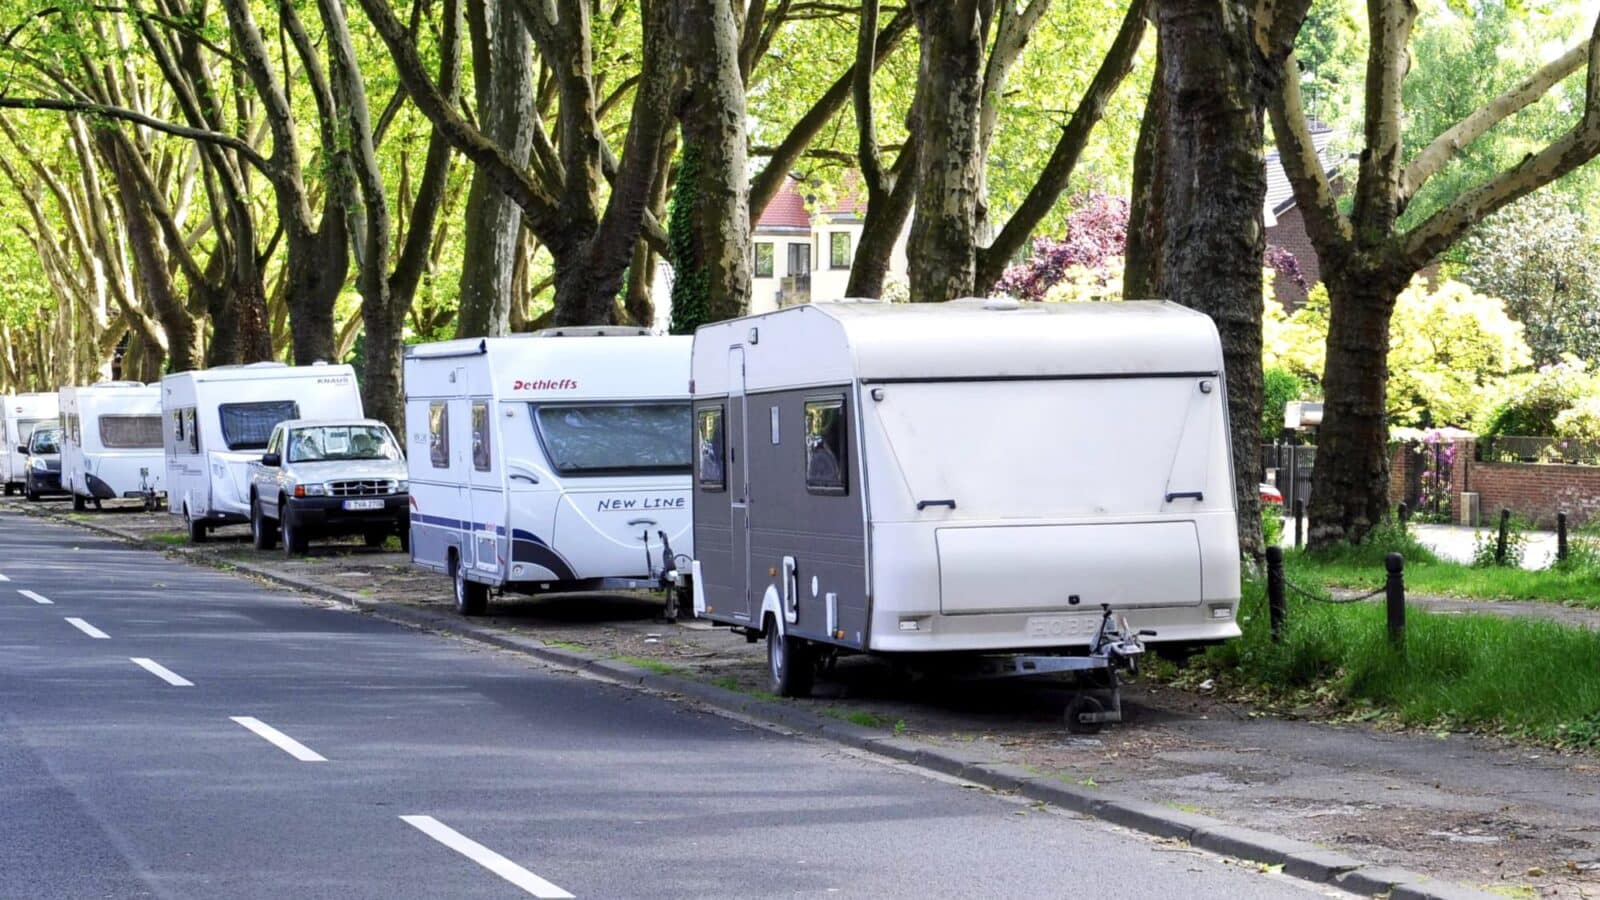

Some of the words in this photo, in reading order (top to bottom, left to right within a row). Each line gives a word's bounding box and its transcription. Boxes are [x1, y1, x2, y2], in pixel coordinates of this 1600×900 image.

[512, 379, 578, 391] Dethleffs
[597, 498, 637, 512] NEW
[643, 497, 686, 509] LINE
[1029, 618, 1098, 637] HOBB
